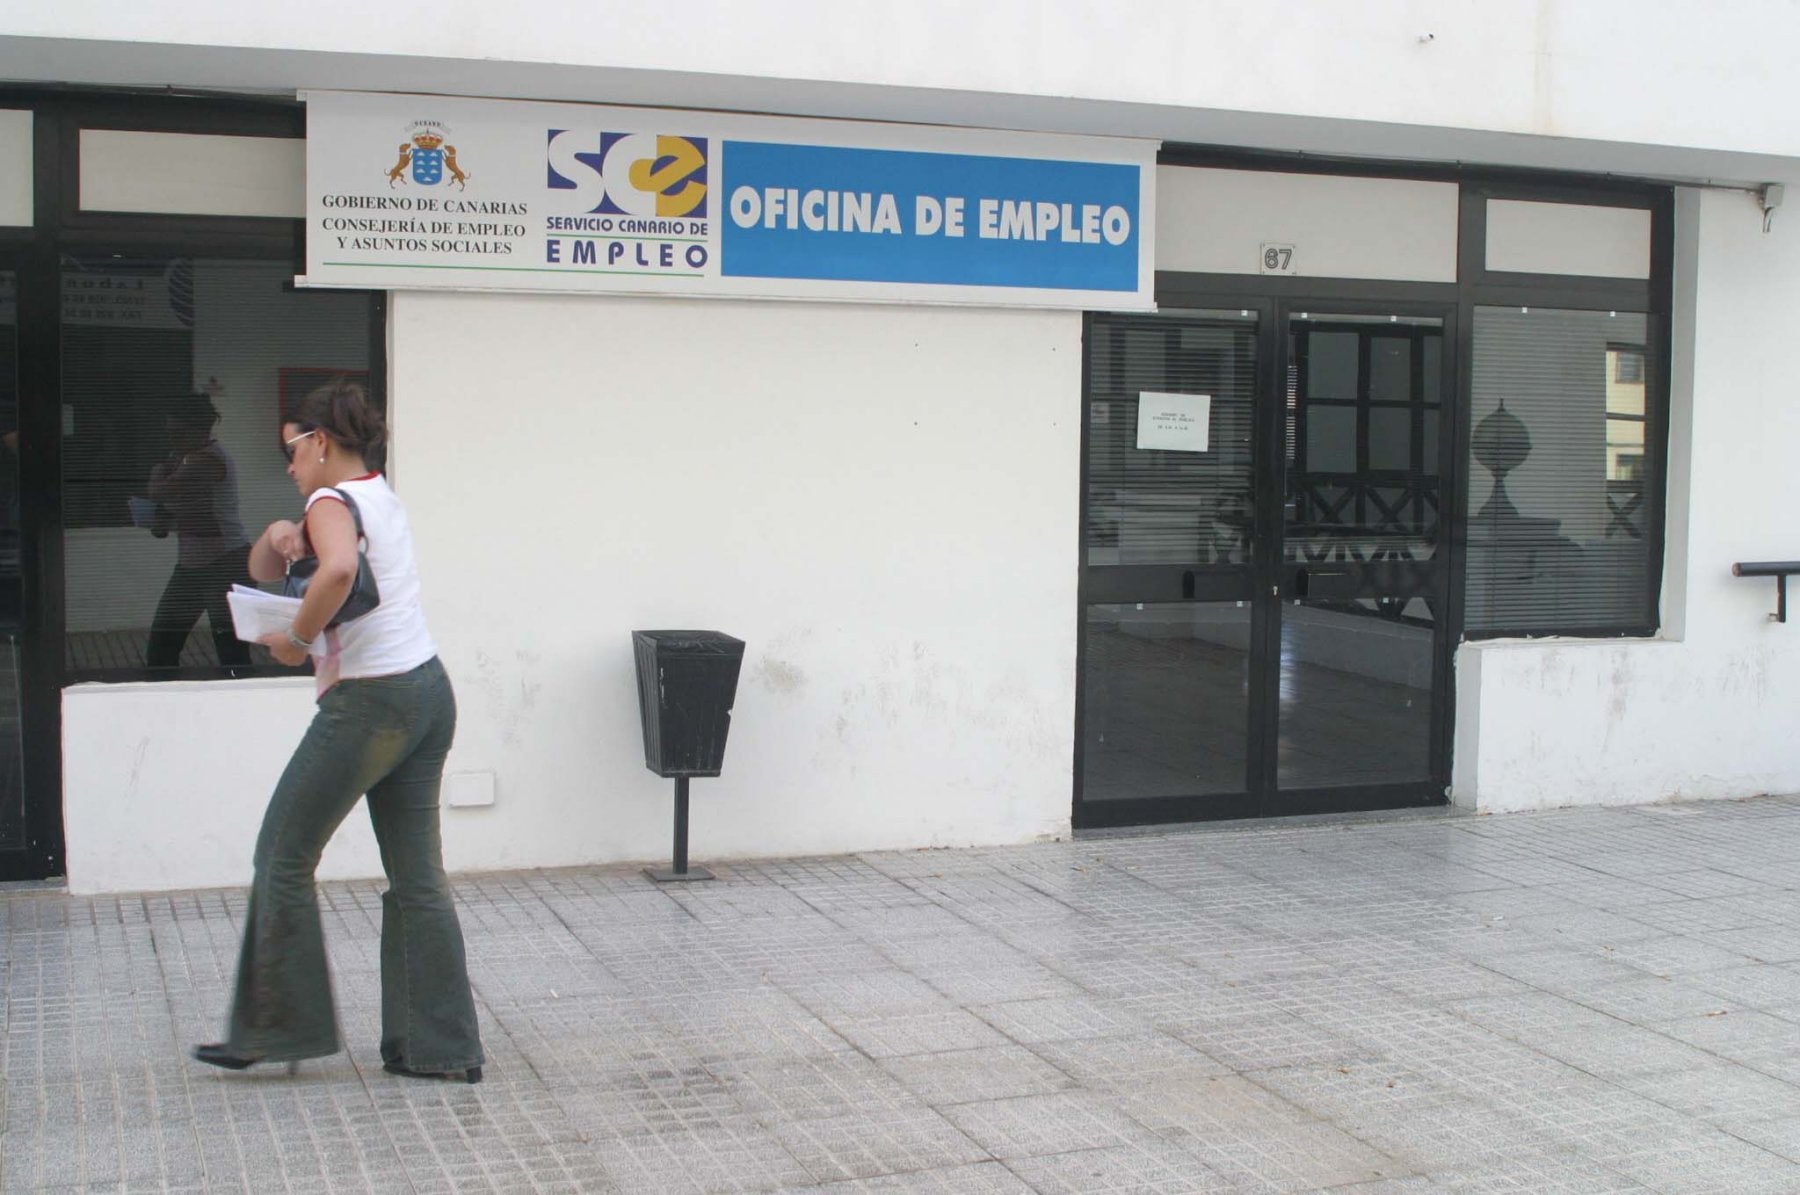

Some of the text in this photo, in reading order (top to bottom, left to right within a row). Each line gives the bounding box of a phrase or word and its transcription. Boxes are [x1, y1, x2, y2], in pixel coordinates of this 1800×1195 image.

[321, 194, 528, 215] GOBIERNO DE CANARIAS
[546, 216, 708, 236] SERVICIO CANARIO DE
[729, 185, 1130, 246] OFICINA DE EMPLEO
[321, 216, 526, 237] CONSEJERÍA DE EMPLEO
[336, 236, 513, 255] Y ASUNTOS SOCIALES
[546, 239, 708, 268] EMPLEO
[1265, 248, 1292, 270] 87
